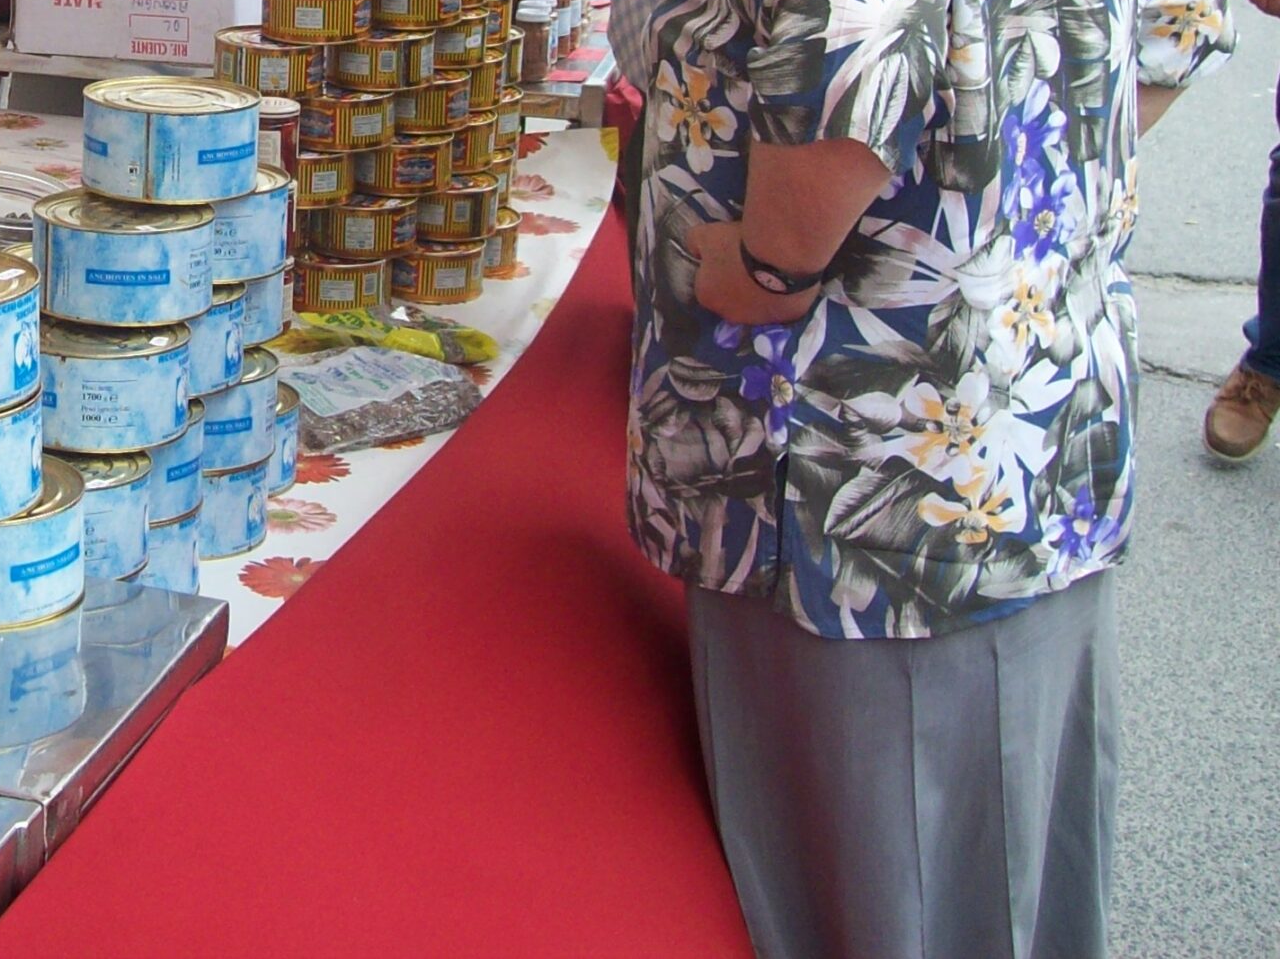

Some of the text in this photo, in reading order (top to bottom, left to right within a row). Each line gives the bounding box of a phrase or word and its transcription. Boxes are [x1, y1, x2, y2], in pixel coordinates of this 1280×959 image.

[131, 40, 188, 57] RIF. CLIENTE
[88, 272, 168, 281] ANCHOVIES IN SALT
[81, 393, 103, 401] 1700
[81, 414, 101, 423] 1000
